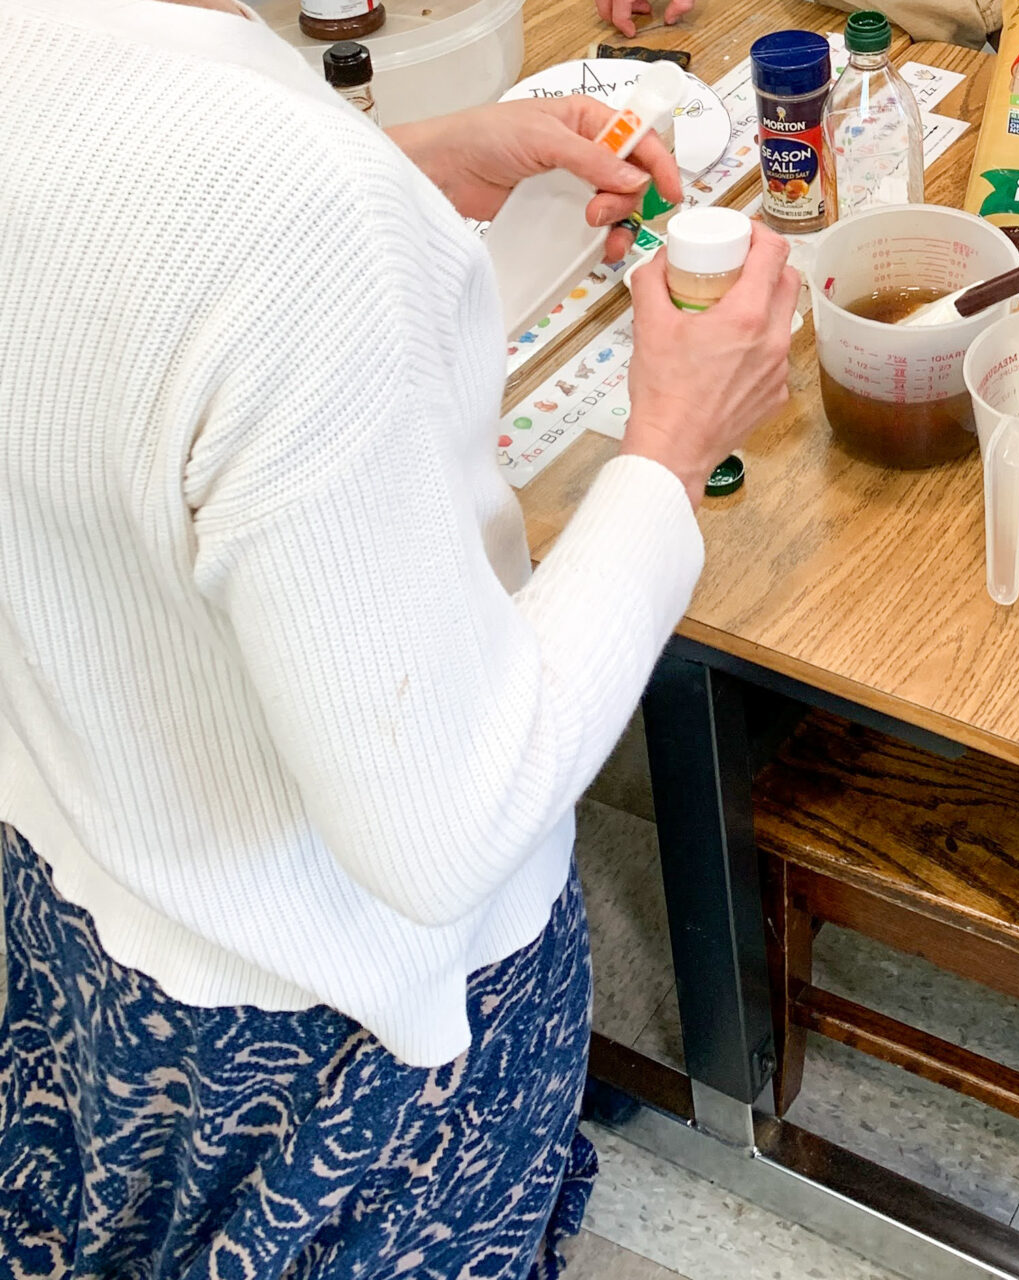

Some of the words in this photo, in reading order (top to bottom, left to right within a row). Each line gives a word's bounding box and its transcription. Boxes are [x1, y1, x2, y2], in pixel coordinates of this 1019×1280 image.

[529, 87, 564, 99] The
[571, 82, 617, 95] story
[763, 117, 806, 131] MORTON
[761, 146, 811, 163] SEASON
[767, 170, 795, 179] SEASONED
[795, 170, 810, 179] SALT
[540, 429, 564, 445] Bb
[563, 409, 586, 425] Cc
[582, 390, 606, 406] Dd
